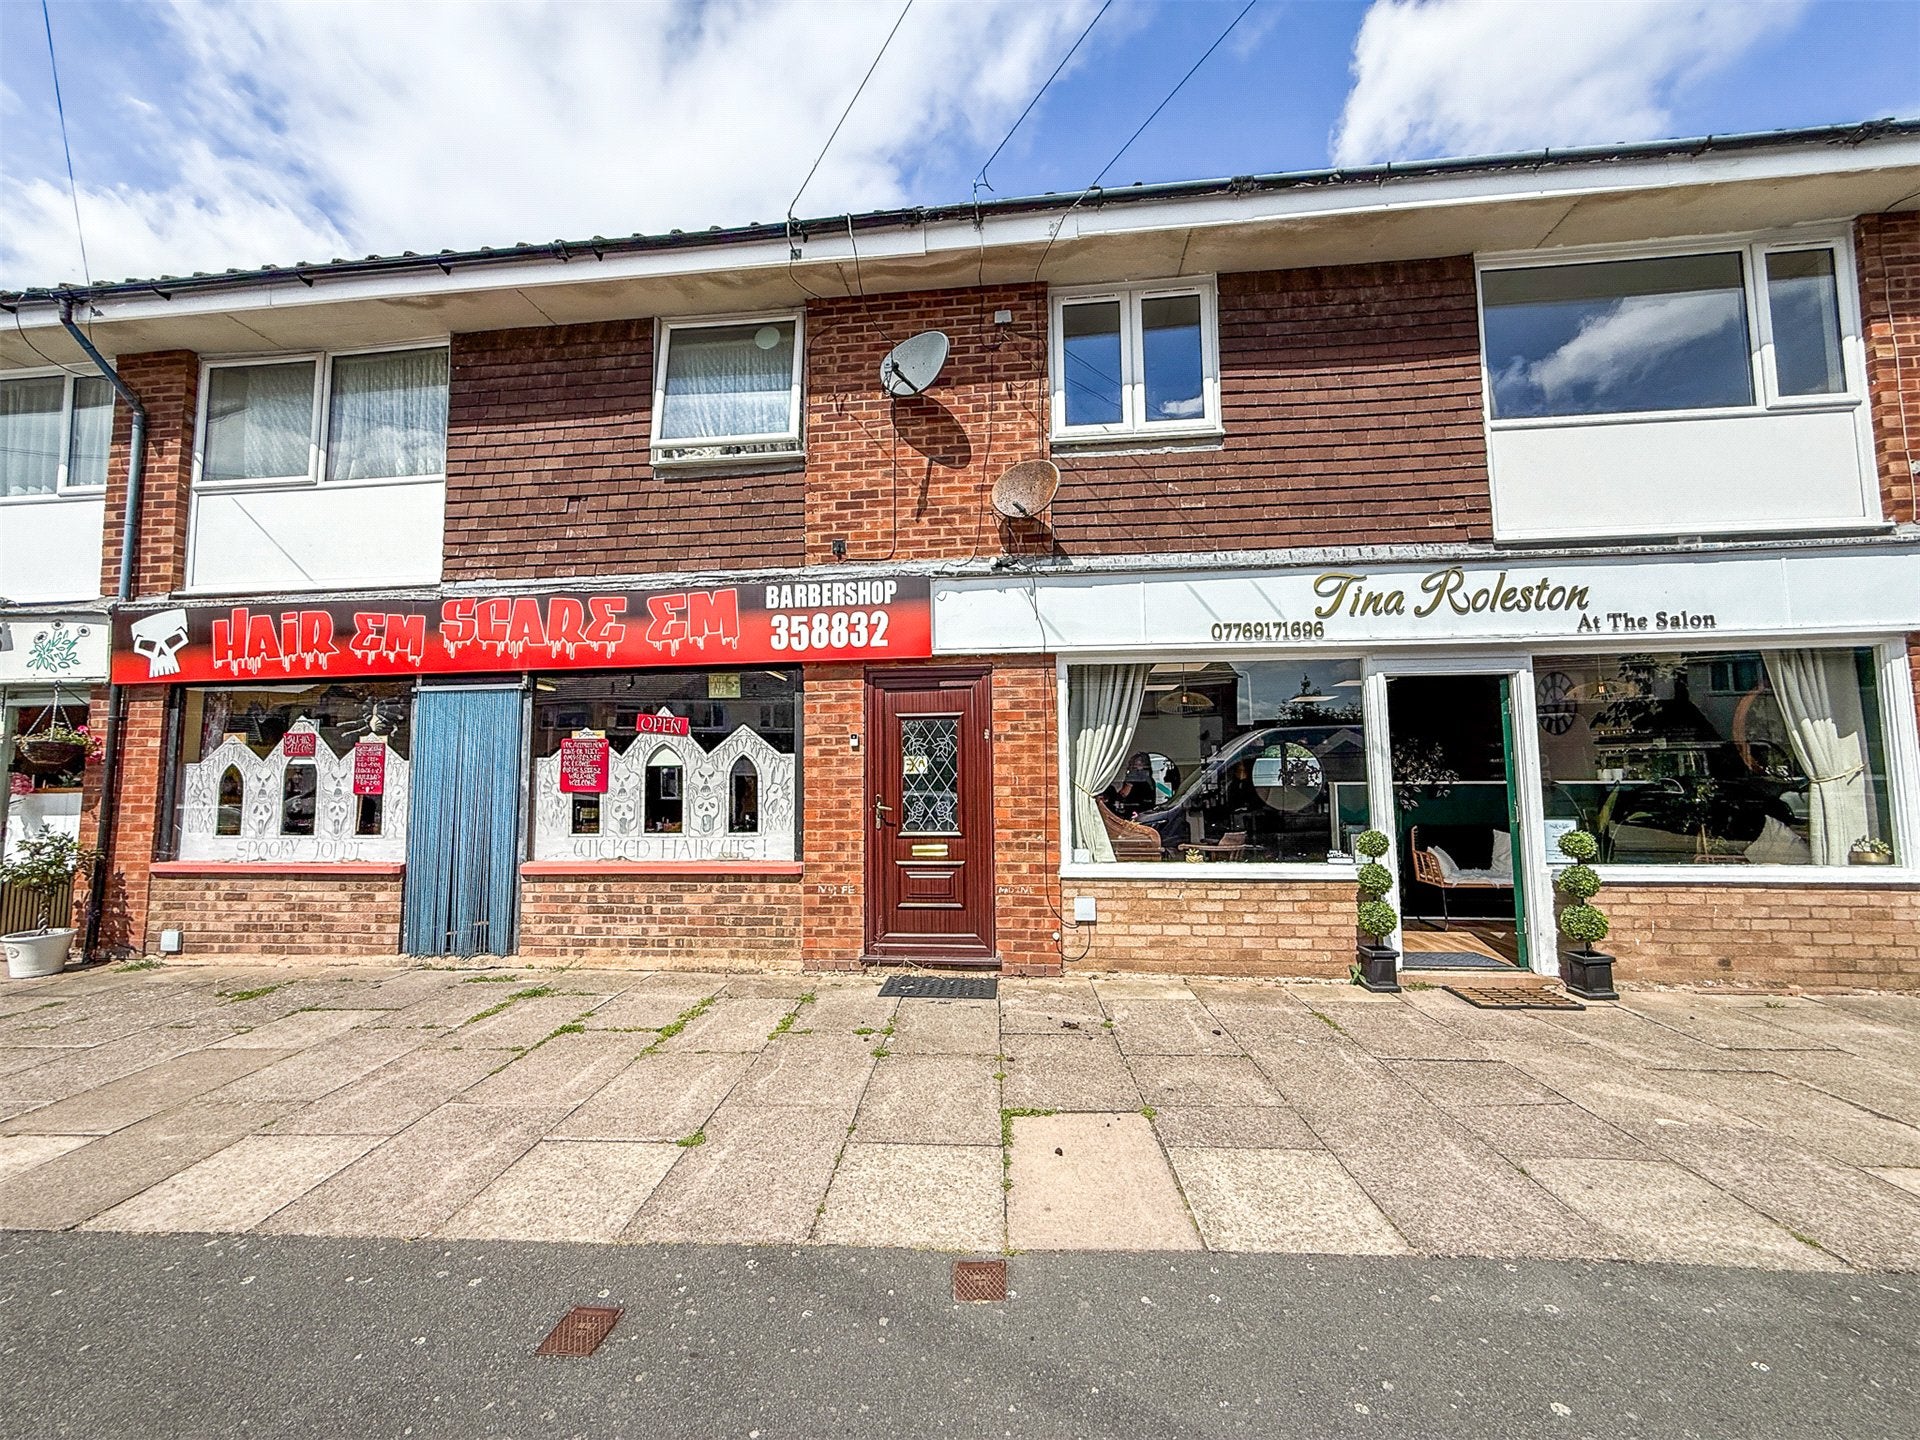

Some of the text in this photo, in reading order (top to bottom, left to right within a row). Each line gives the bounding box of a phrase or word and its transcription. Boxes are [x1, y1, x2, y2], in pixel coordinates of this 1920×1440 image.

[765, 580, 897, 609] BARBERSHOP
[1313, 565, 1590, 619] Tina Roleston
[349, 613, 426, 667] EM
[439, 597, 627, 660] SCARE
[646, 588, 740, 657] EM
[770, 610, 889, 651] 358832
[1211, 621, 1324, 641] 07769171696
[1577, 610, 1716, 633] At The Salon
[641, 717, 681, 733] OPEN
[236, 839, 363, 862] SPOOKY JOINT
[573, 839, 650, 858] WICKED
